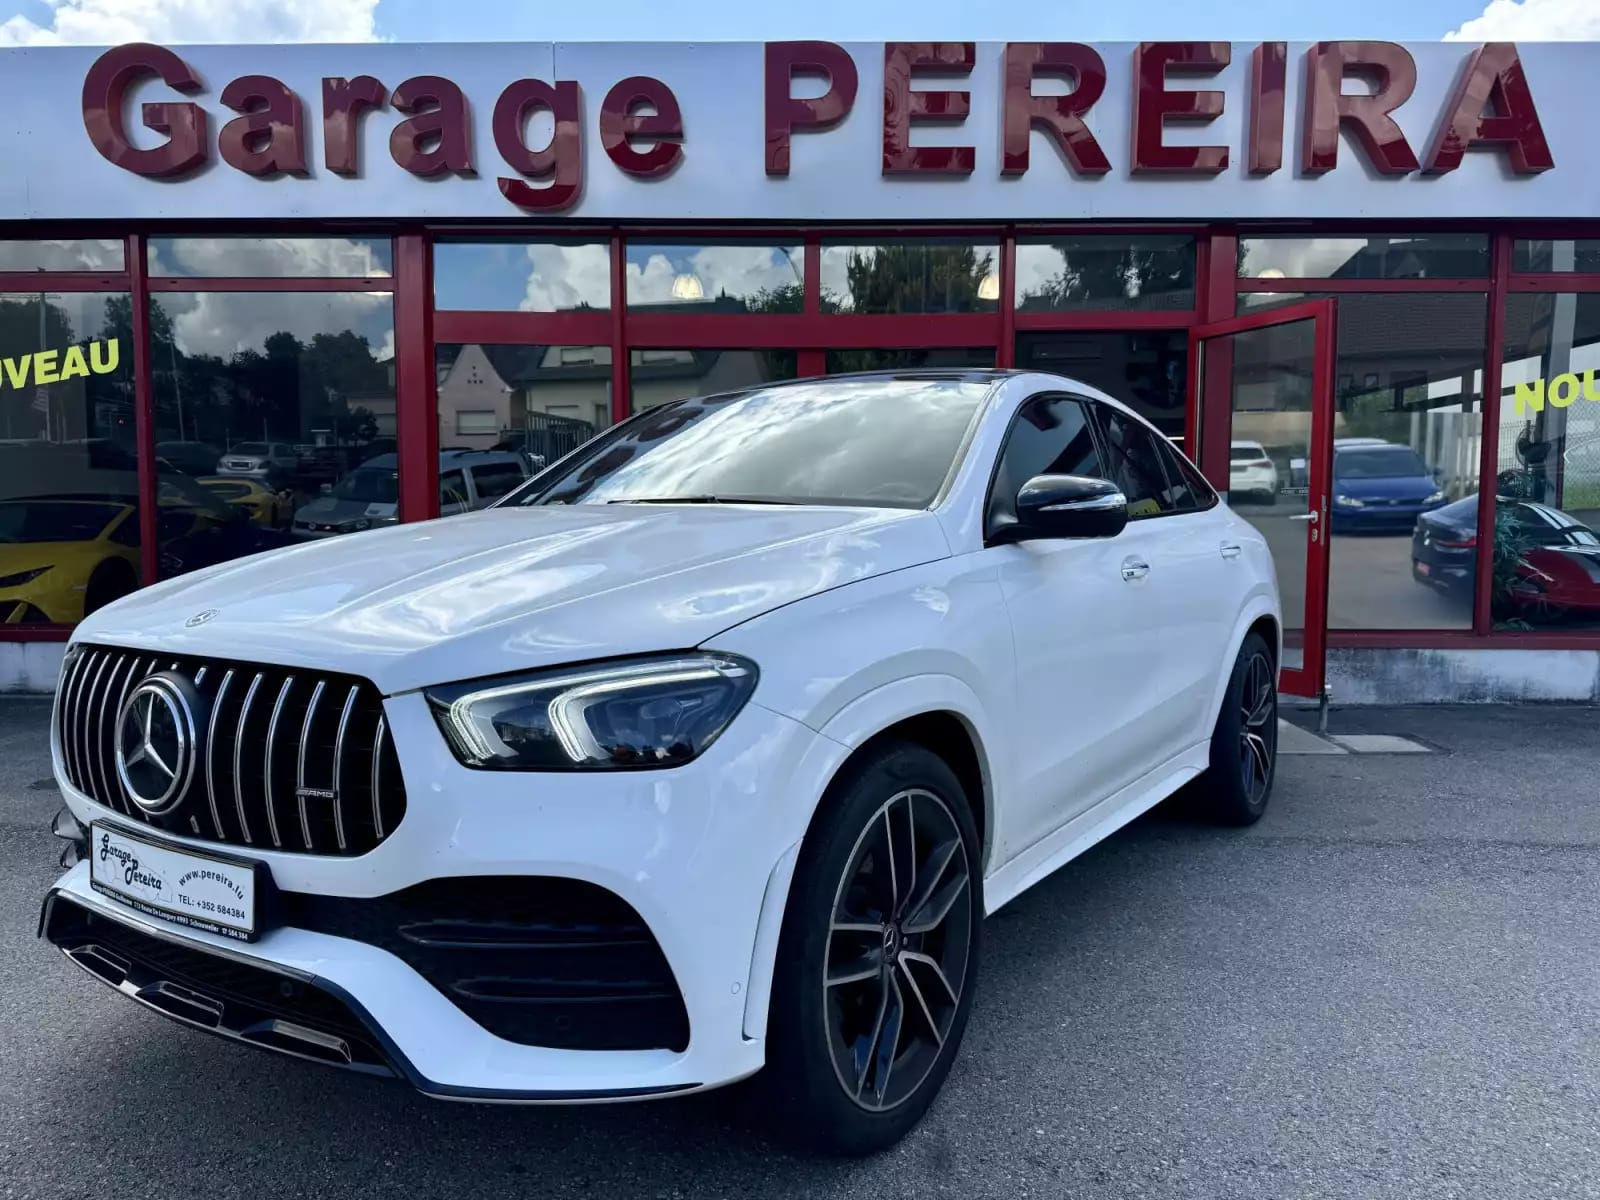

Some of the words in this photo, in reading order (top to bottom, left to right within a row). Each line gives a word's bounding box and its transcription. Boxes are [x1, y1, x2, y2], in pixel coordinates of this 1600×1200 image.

[82, 43, 686, 212] Garage
[764, 41, 1555, 177] PEREIRA
[0, 338, 119, 389] VEAU
[101, 833, 132, 867] Garage
[125, 858, 162, 890] Pereira
[178, 870, 244, 900] www.pereira.lu
[178, 893, 195, 907] TEL:
[196, 900, 215, 912] +352
[216, 904, 246, 920] 584384
